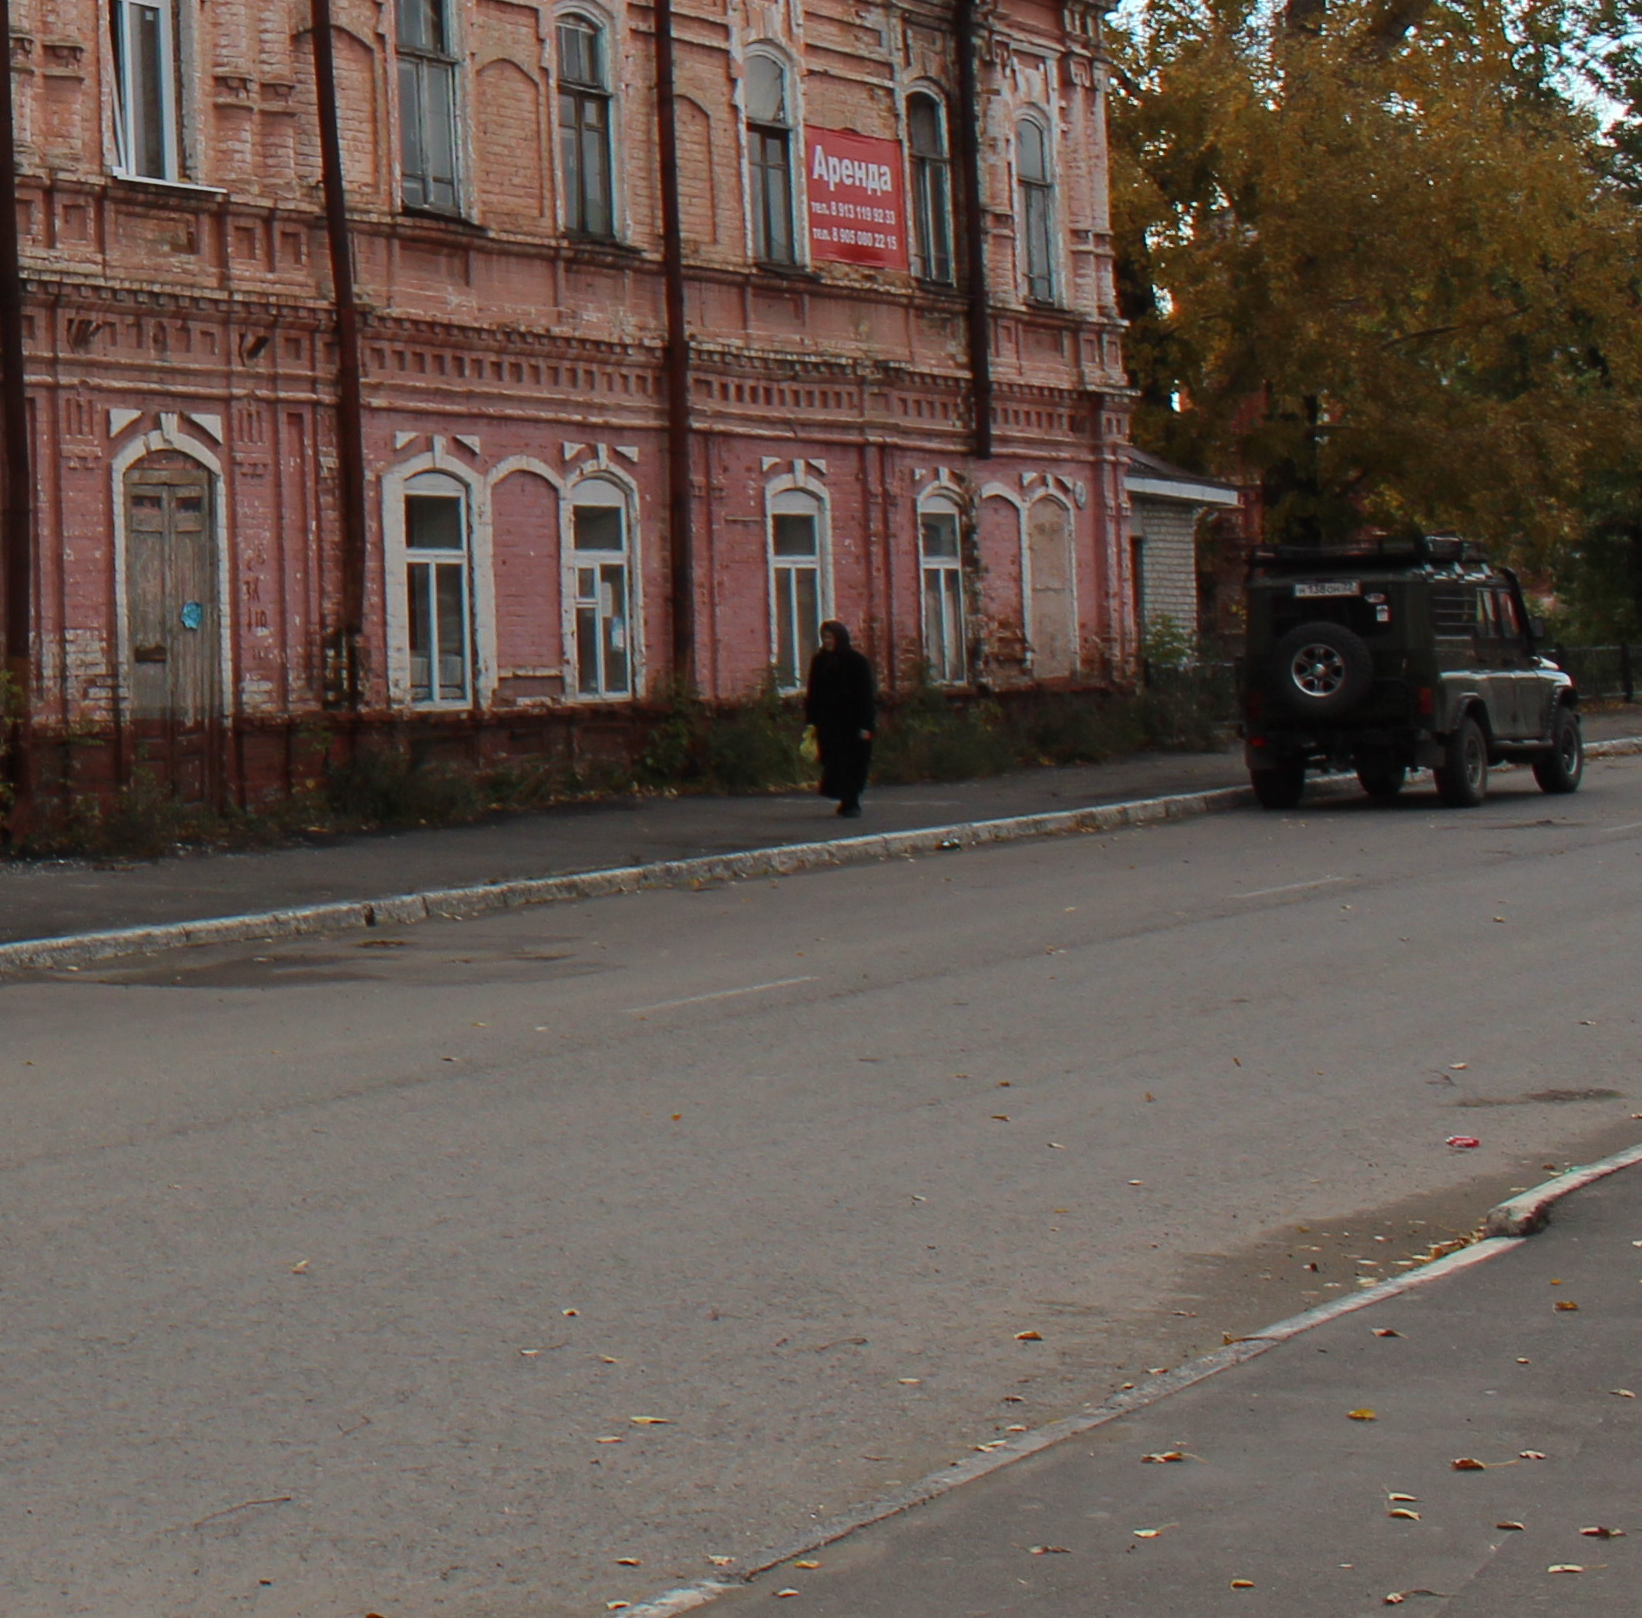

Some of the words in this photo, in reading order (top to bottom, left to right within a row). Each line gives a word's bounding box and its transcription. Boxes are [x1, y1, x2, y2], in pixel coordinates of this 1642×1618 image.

[812, 145, 892, 196] Аренда
[811, 201, 830, 215] тел.
[830, 201, 837, 216] 8
[838, 202, 854, 219] 913
[856, 205, 872, 221] 119
[872, 208, 884, 223] 92
[884, 209, 896, 225] 33
[812, 227, 831, 241] тел.
[832, 226, 839, 242] 8
[839, 228, 856, 244] 905
[874, 233, 886, 249] 22
[887, 235, 897, 250] 15
